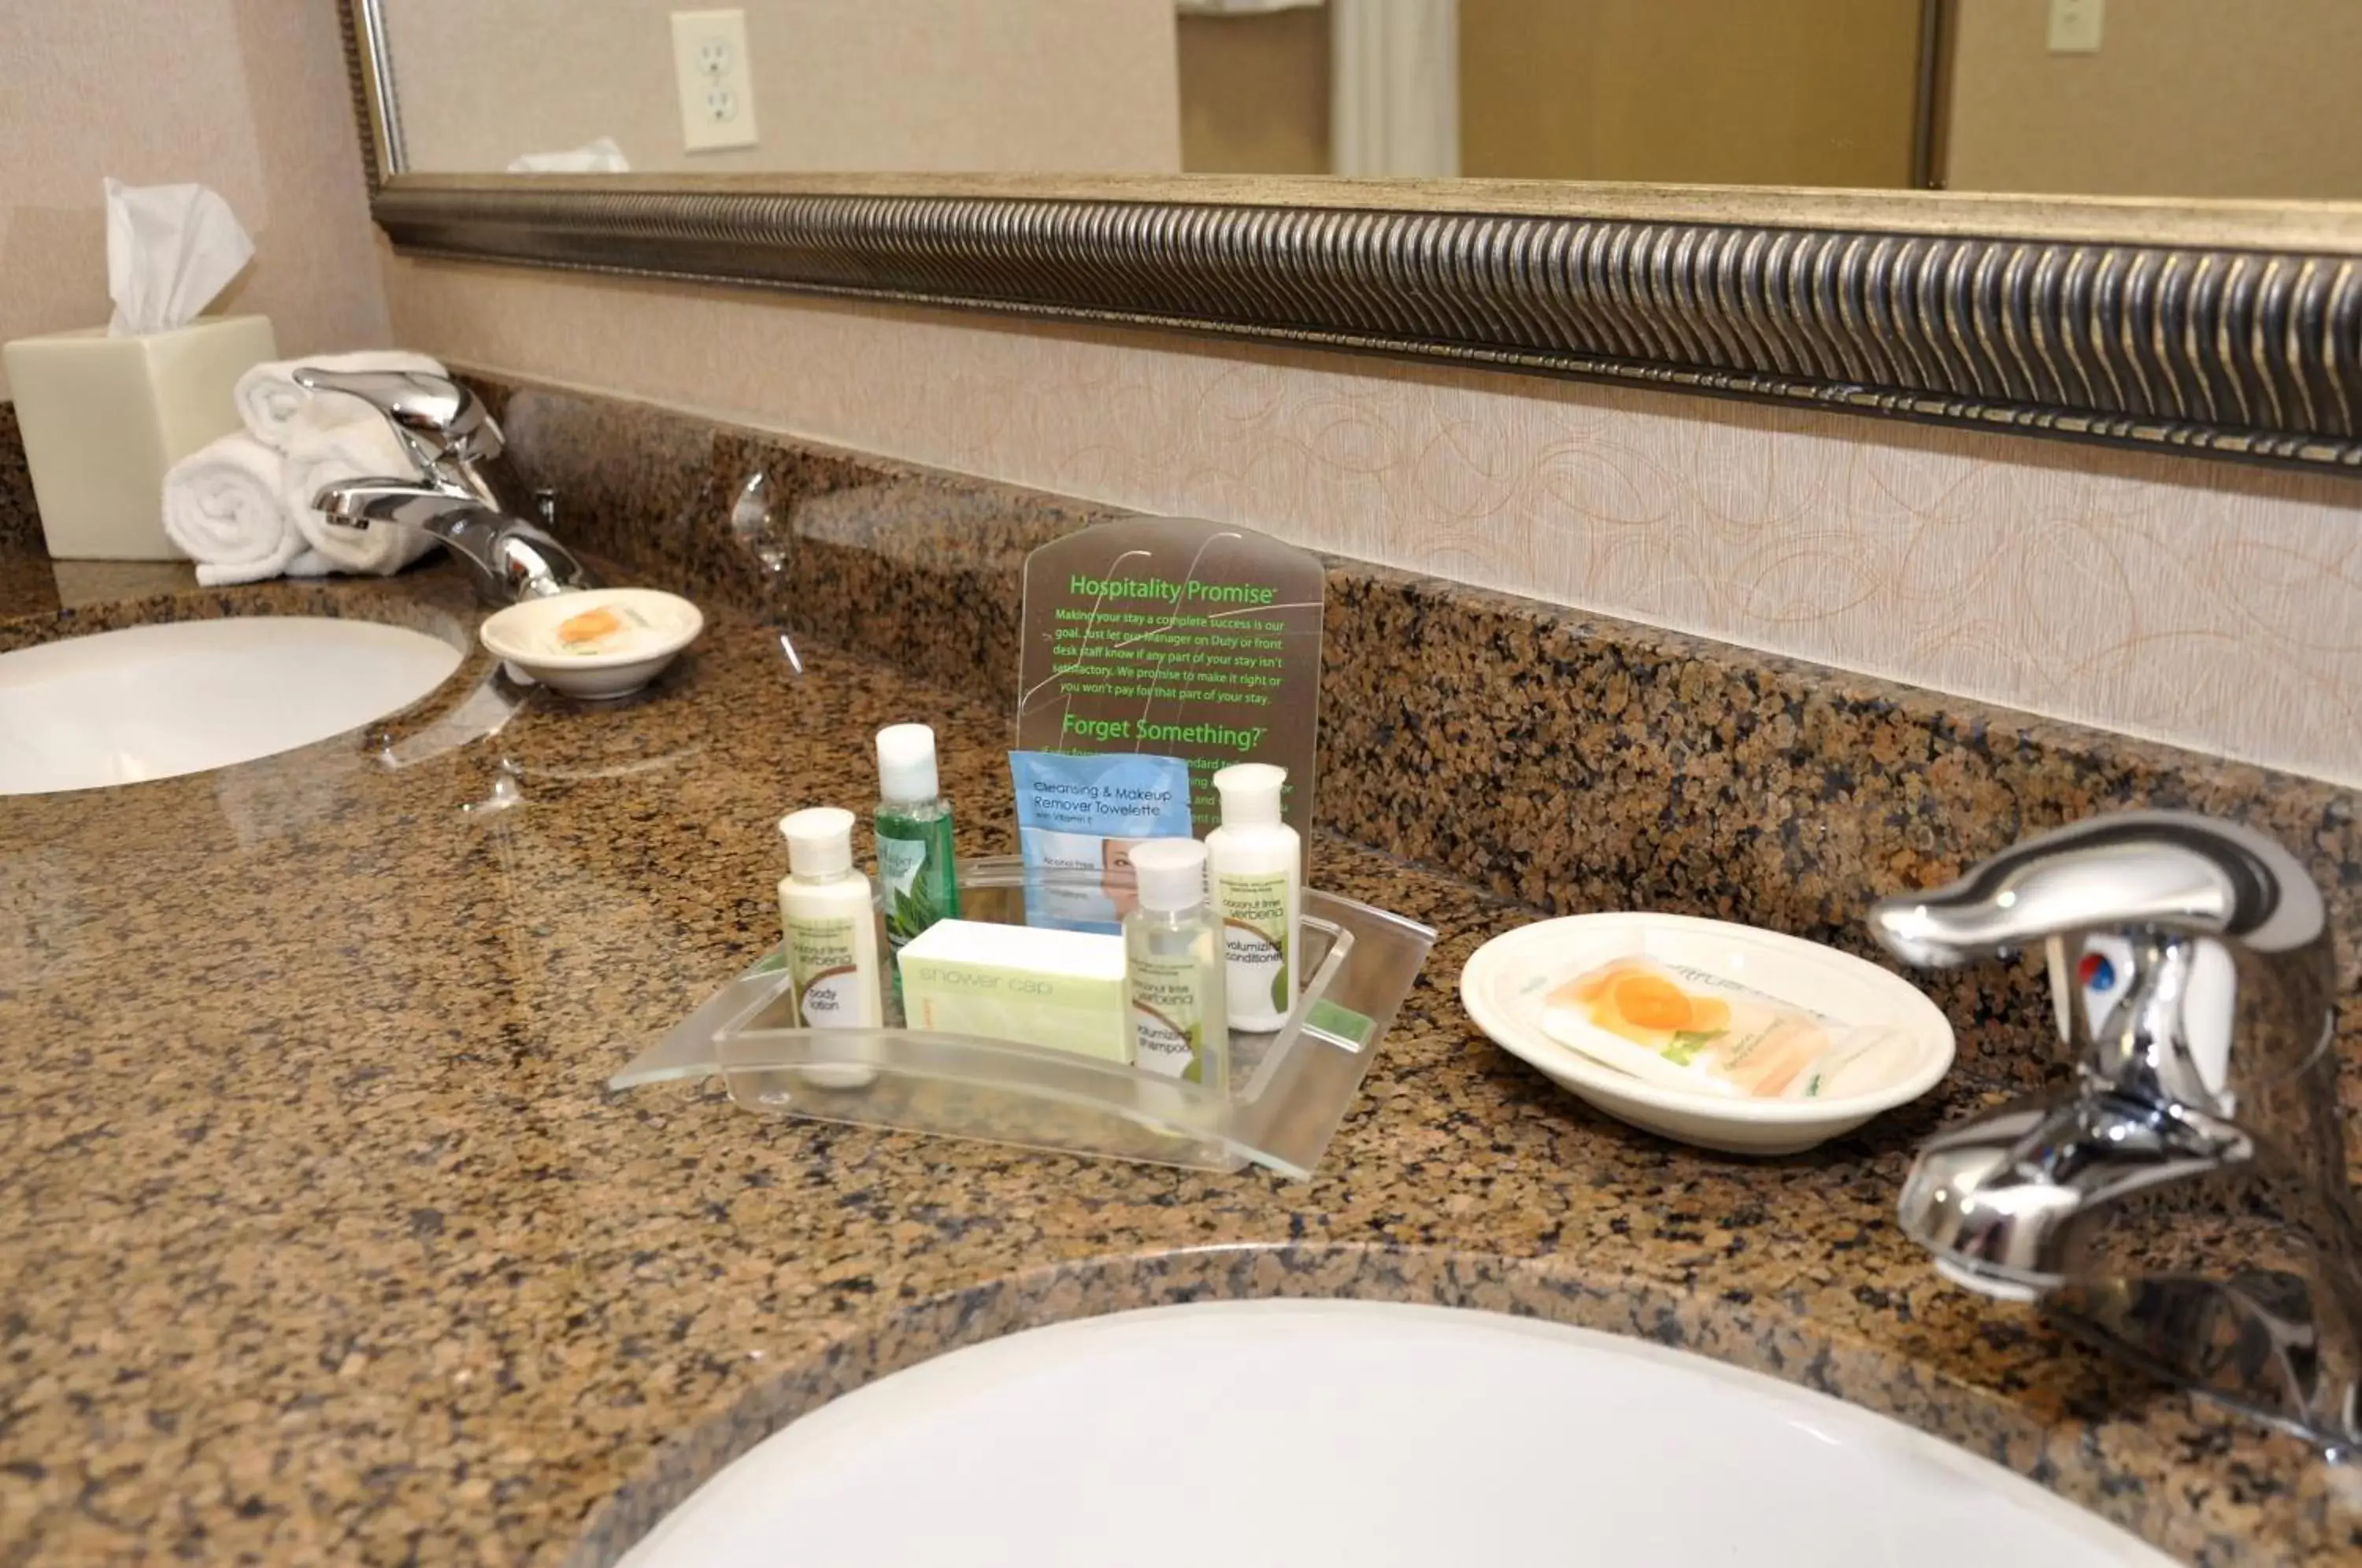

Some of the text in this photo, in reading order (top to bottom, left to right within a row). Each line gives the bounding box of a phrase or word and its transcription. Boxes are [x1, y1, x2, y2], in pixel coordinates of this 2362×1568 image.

[1071, 575, 1273, 605] Hospitality Promise
[1055, 608, 1093, 624] Making
[1094, 612, 1121, 625] your
[1124, 613, 1145, 627] stay
[1156, 616, 1207, 628] complete
[1209, 619, 1251, 629] success
[1254, 619, 1262, 630] is
[1264, 622, 1285, 631] our
[1055, 627, 1081, 640] goal.
[1084, 629, 1104, 639] Just
[1106, 629, 1120, 641] let
[1143, 631, 1191, 646] Manager
[1194, 636, 1209, 645] on
[1212, 634, 1238, 649] Duty
[1254, 638, 1283, 649] front
[1053, 643, 1283, 669] desk staff know if any part of your stay isn't
[1053, 663, 1283, 687] satisfactory. We promise to make it right or
[1060, 682, 1272, 706] you won't pay for that part of your stay.
[1061, 713, 1261, 752] Forget Something?
[1033, 782, 1172, 802] Cleansing & Makeup
[1034, 795, 1161, 817] Remover Towelette
[1054, 813, 1086, 824] Vitamin
[1229, 904, 1284, 919] verbena
[1224, 937, 1283, 952] volumizing
[1225, 951, 1283, 963] conditioner
[919, 967, 1054, 996] shower cap
[808, 988, 838, 1001] body
